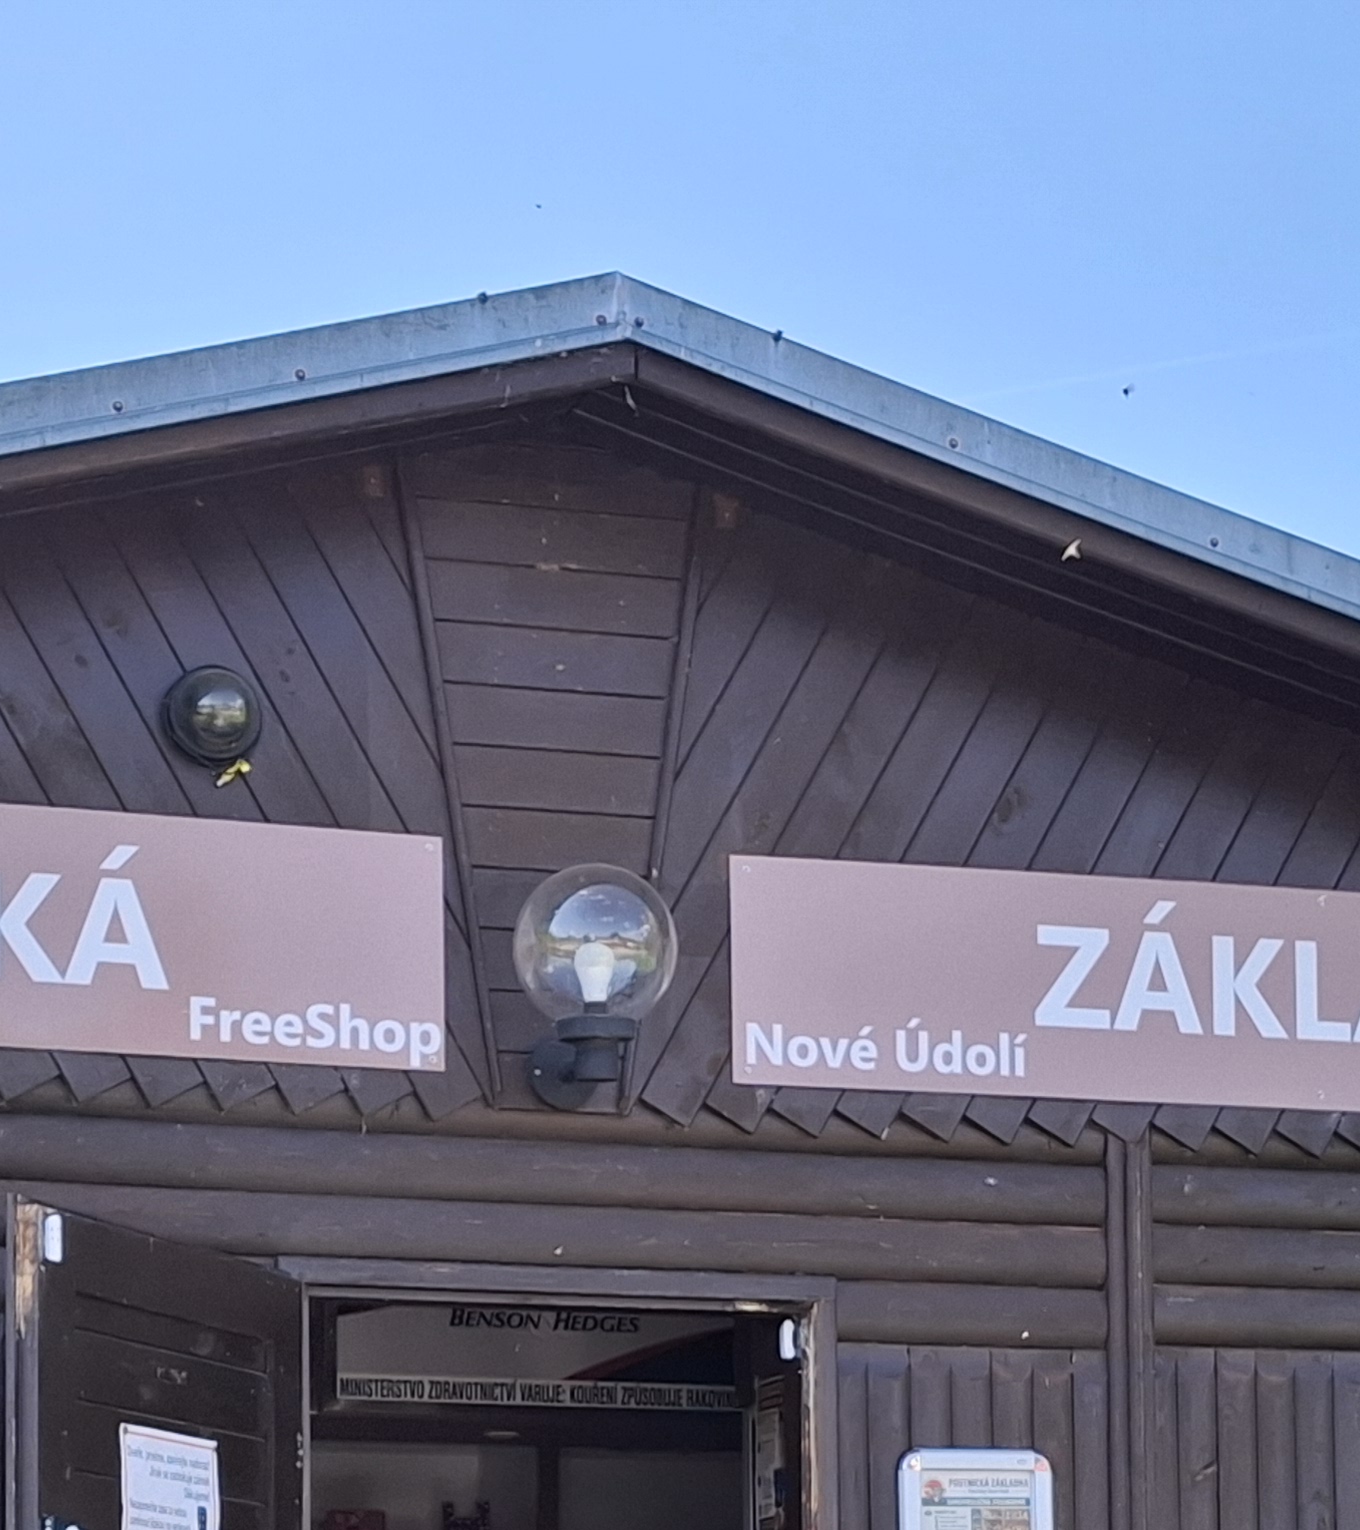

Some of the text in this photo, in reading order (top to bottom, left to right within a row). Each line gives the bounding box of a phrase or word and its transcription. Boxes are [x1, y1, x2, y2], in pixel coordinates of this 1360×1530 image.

[189, 995, 442, 1068] FreeShop
[744, 1016, 1028, 1078] Nové Údolí
[449, 1307, 641, 1333] BENSON HEDGES
[339, 1377, 425, 1399] MINISTERSTVO
[427, 1377, 517, 1402] ZDRAVOTNICTVÍ
